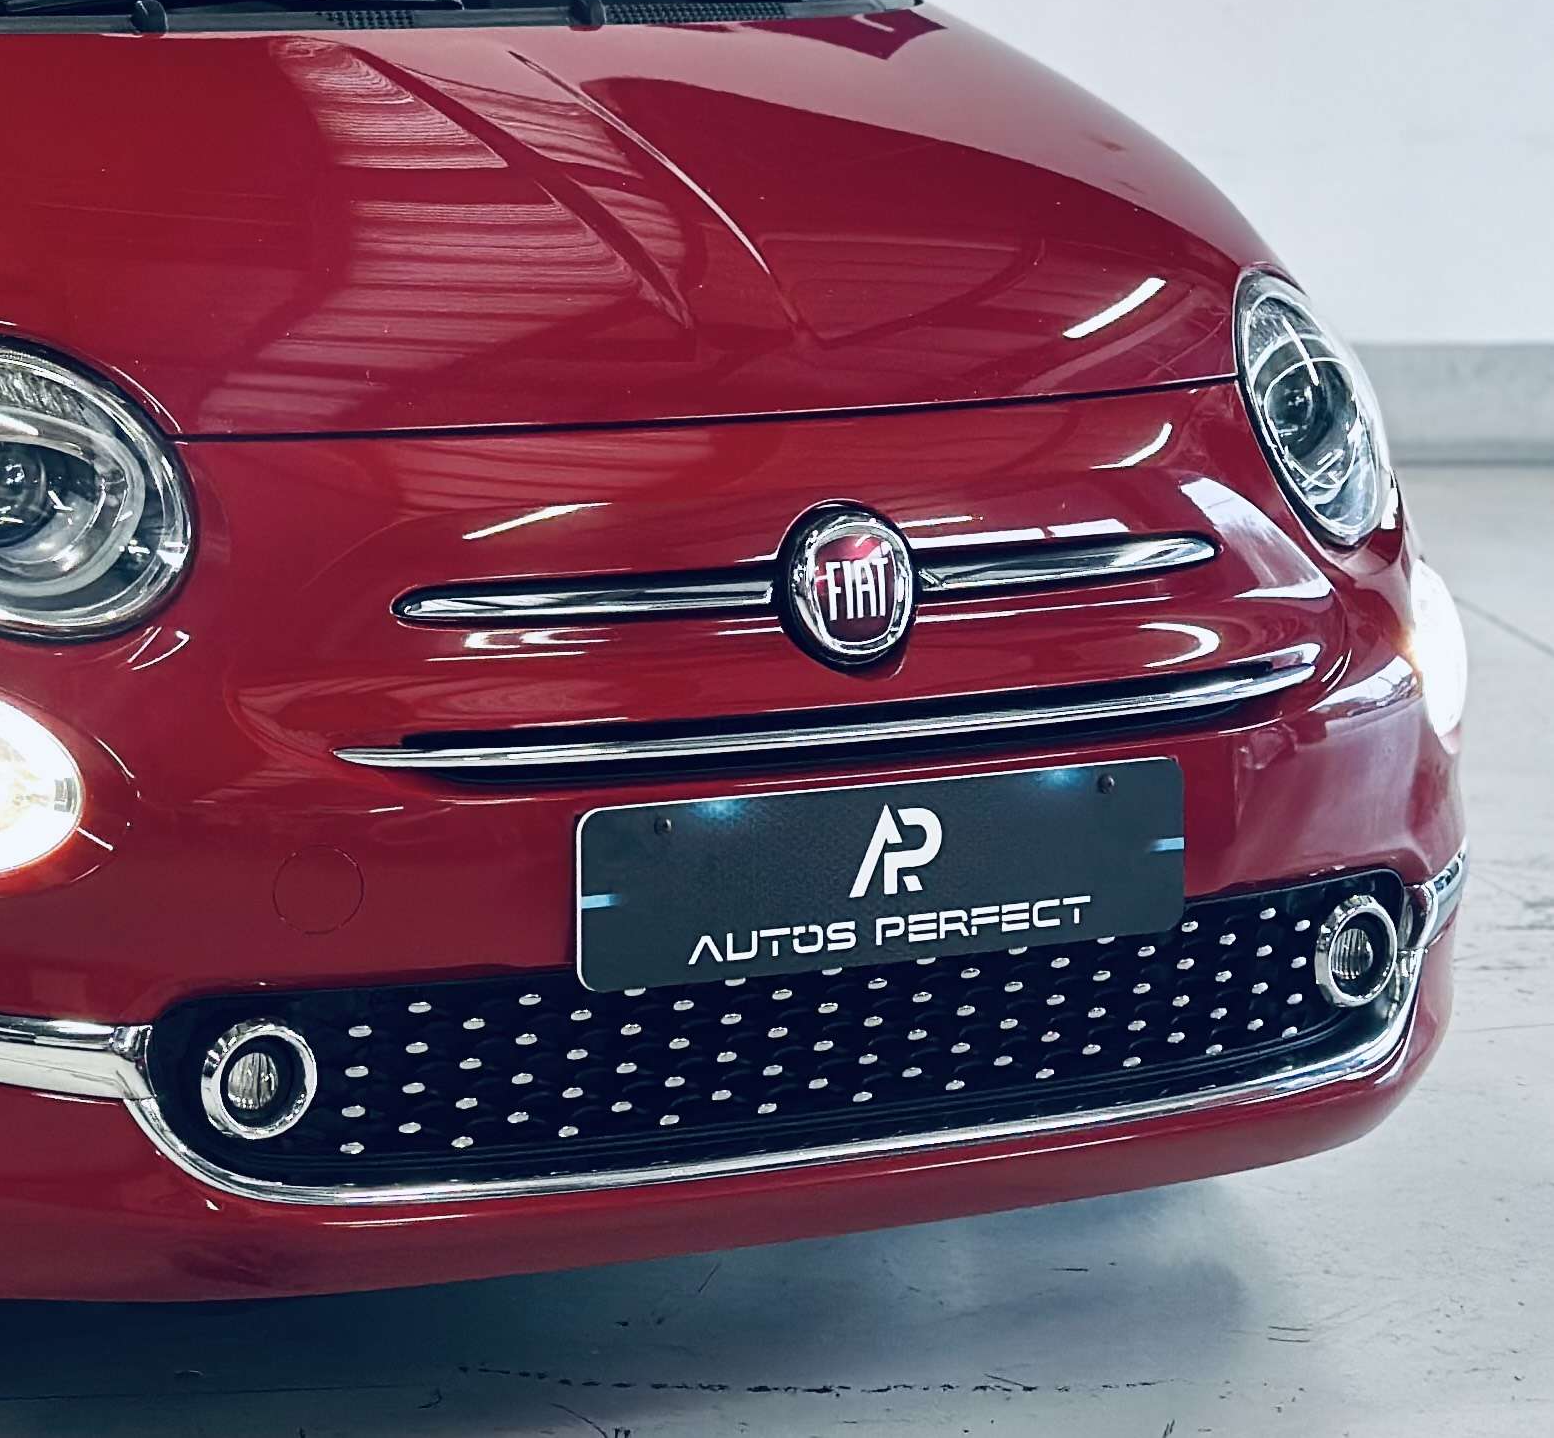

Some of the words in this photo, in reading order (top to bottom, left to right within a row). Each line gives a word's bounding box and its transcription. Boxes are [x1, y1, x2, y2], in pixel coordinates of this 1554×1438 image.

[825, 557, 889, 621] FIAT
[688, 921, 857, 965] AUTOS
[875, 895, 1091, 946] PERFECT
